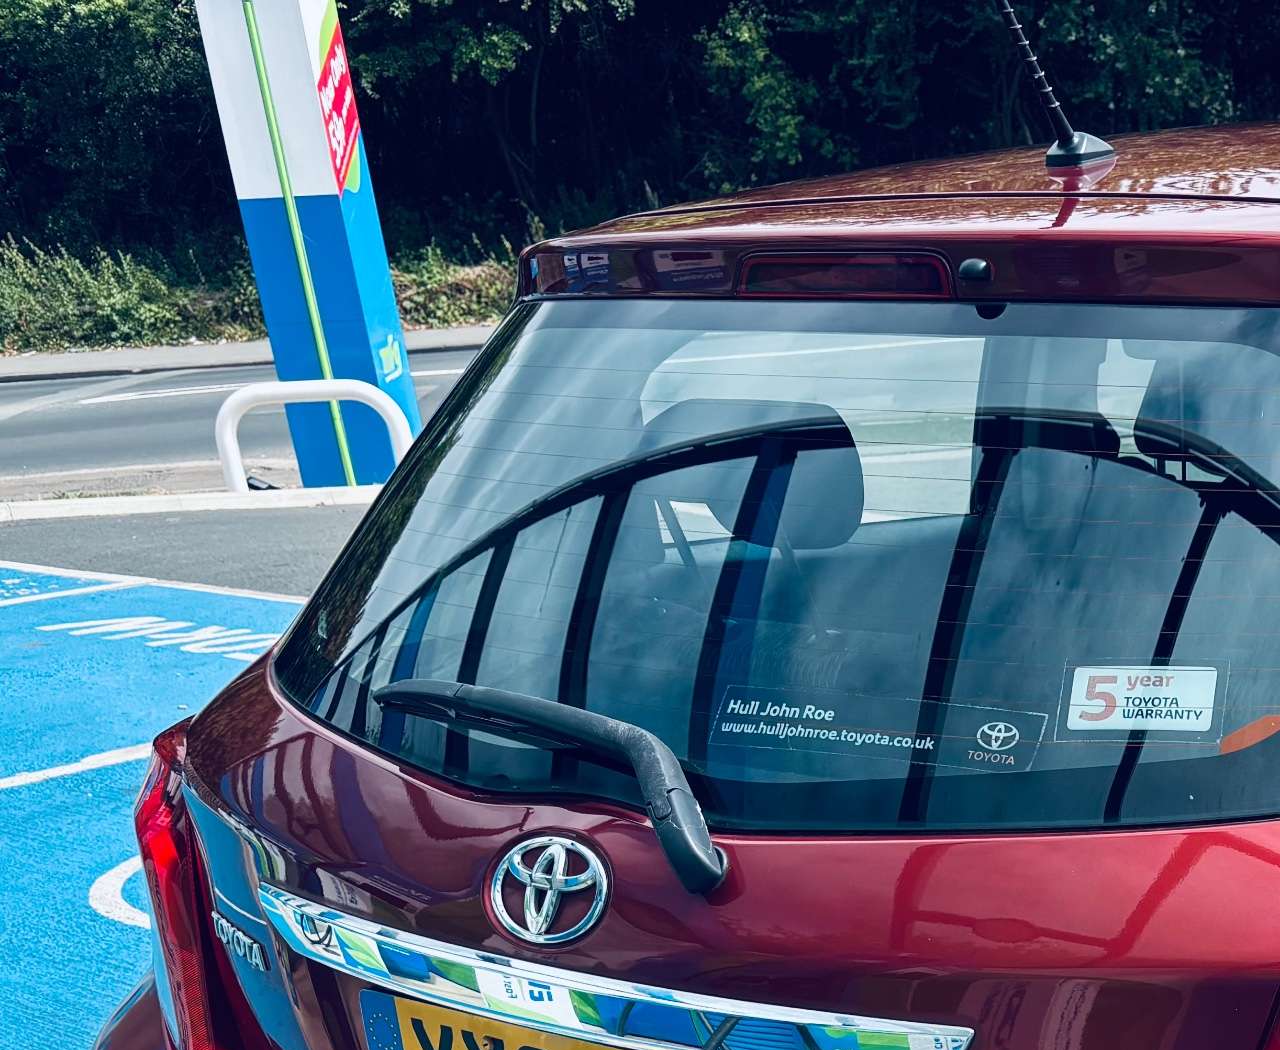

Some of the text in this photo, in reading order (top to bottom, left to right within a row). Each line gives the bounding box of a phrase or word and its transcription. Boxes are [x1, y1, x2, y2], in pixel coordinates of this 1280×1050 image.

[1078, 673, 1175, 721] 5 year
[1124, 696, 1180, 708] TOYOTA
[726, 699, 835, 721] Hull John Roe
[1122, 708, 1203, 721] WARRANTY
[721, 721, 935, 751] www.hulljohnroe.toyota.co.uk
[967, 750, 1015, 766] TOYOTA
[211, 910, 265, 972] TOYOTA
